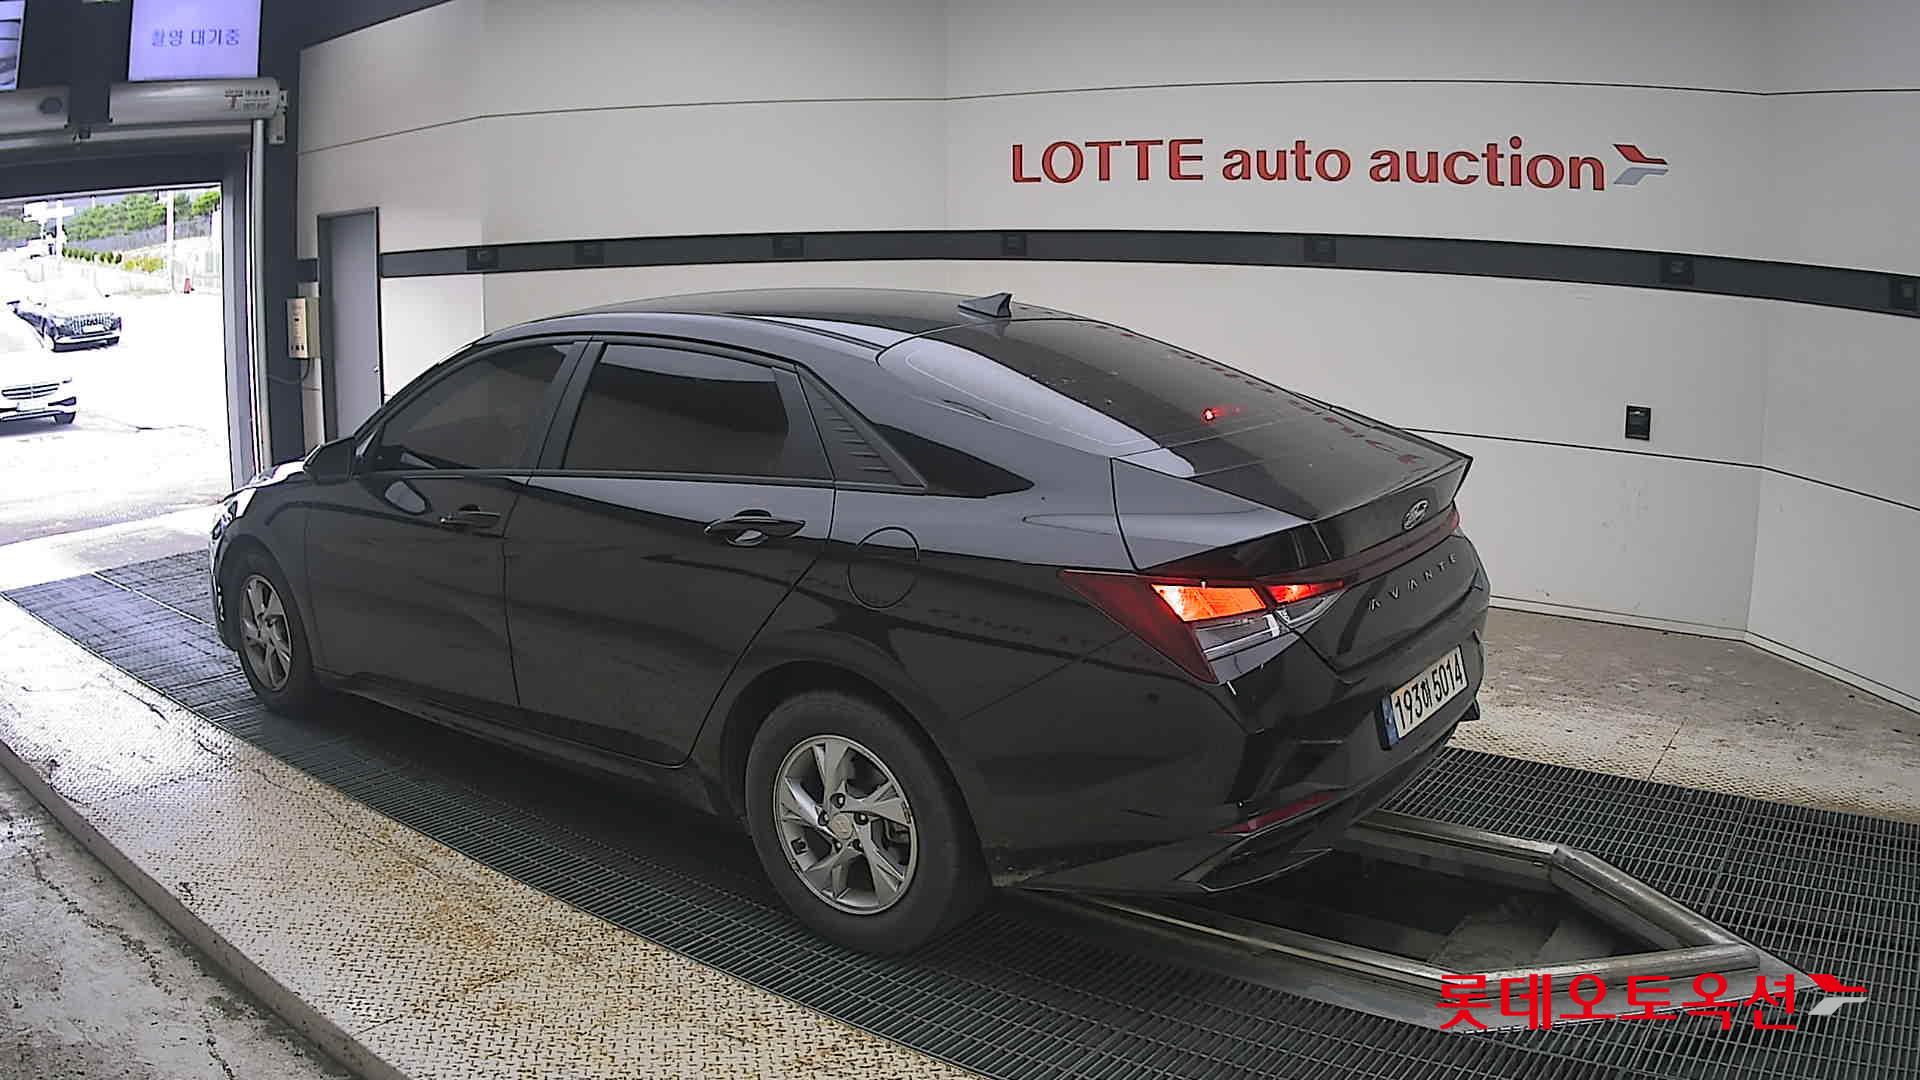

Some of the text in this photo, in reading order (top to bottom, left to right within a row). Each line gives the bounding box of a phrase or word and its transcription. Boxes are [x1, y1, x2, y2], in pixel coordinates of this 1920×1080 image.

[191, 28, 240, 46] 대기중
[1011, 135, 1606, 191] LOTTE auto auction
[1368, 552, 1457, 612] AVANTE
[1431, 653, 1464, 702] 5014
